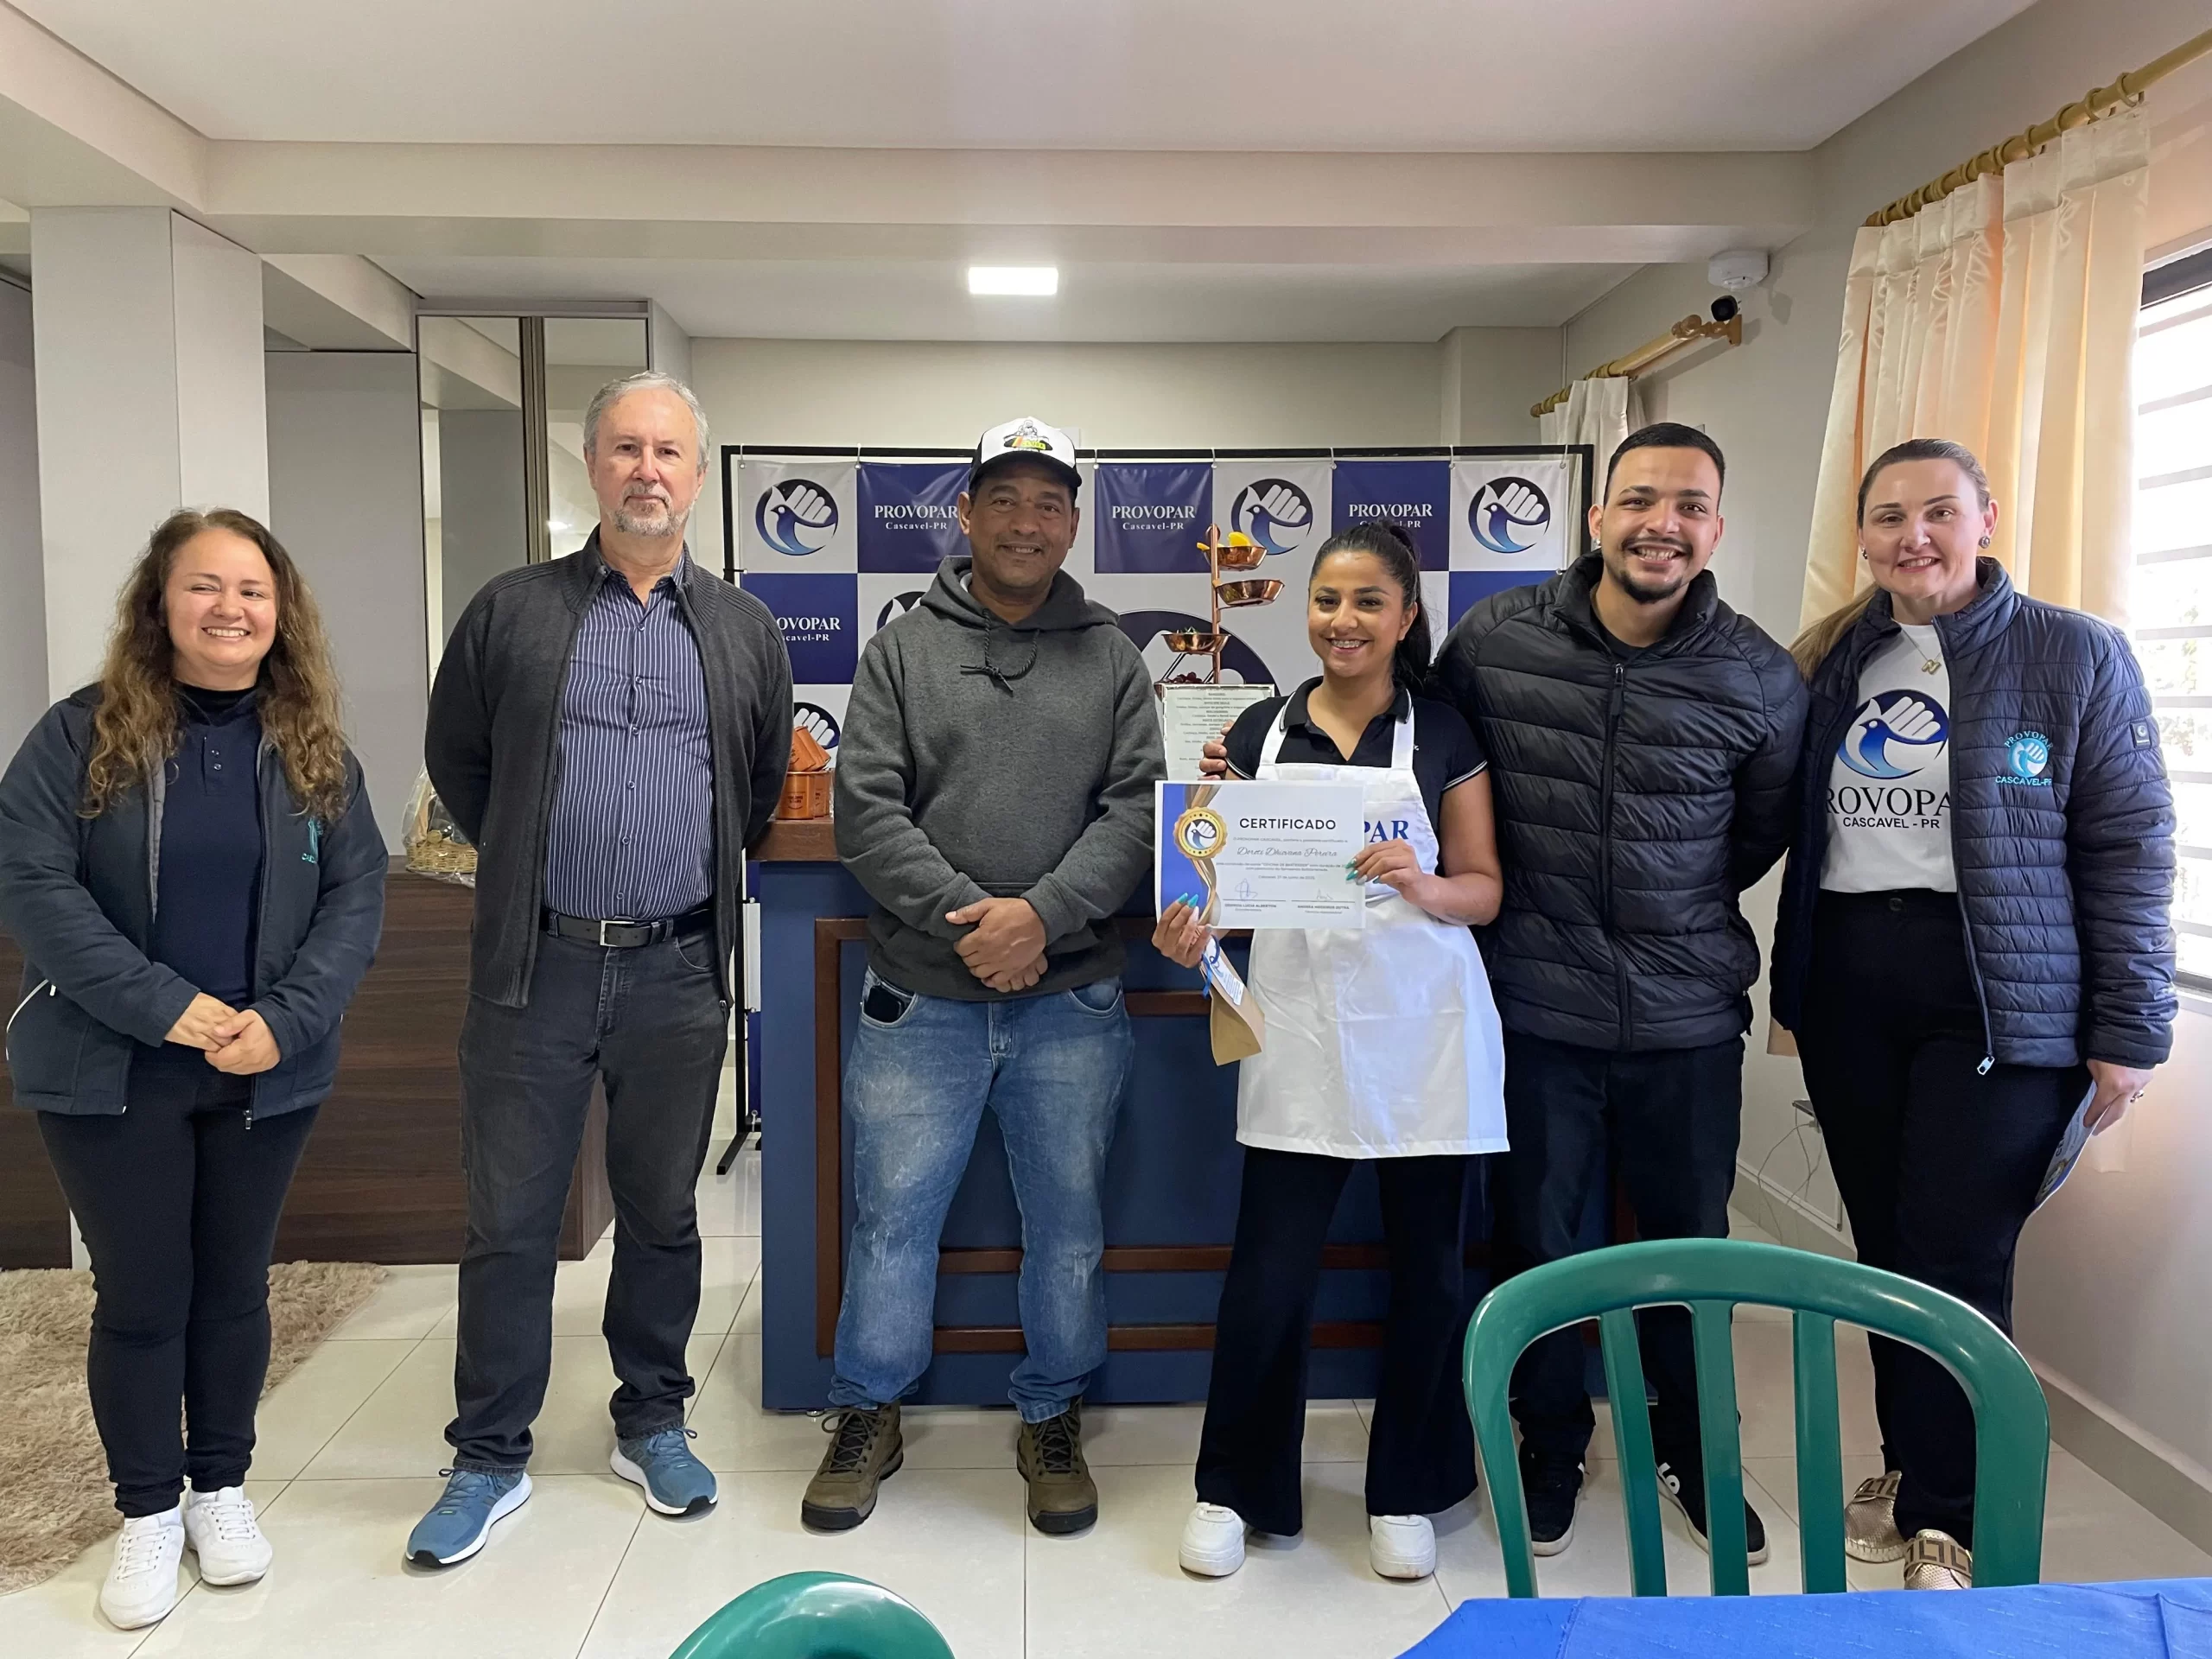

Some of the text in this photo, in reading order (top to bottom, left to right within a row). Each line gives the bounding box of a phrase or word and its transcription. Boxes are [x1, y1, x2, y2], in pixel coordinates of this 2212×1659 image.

[874, 505, 958, 518] PROVOPAR
[1112, 505, 1196, 518] PROVOPAR
[1349, 504, 1433, 518] PROVOPAR
[885, 521, 948, 530] Cascavel-PR
[776, 617, 841, 631] OVOPAR
[2005, 731, 2054, 750] PROVOPAR
[1826, 786, 1950, 816] ROVOPA
[1239, 817, 1337, 830] CERTIFICADO
[1843, 817, 1910, 829] CASCAVEL
[1922, 819, 1940, 829] PR
